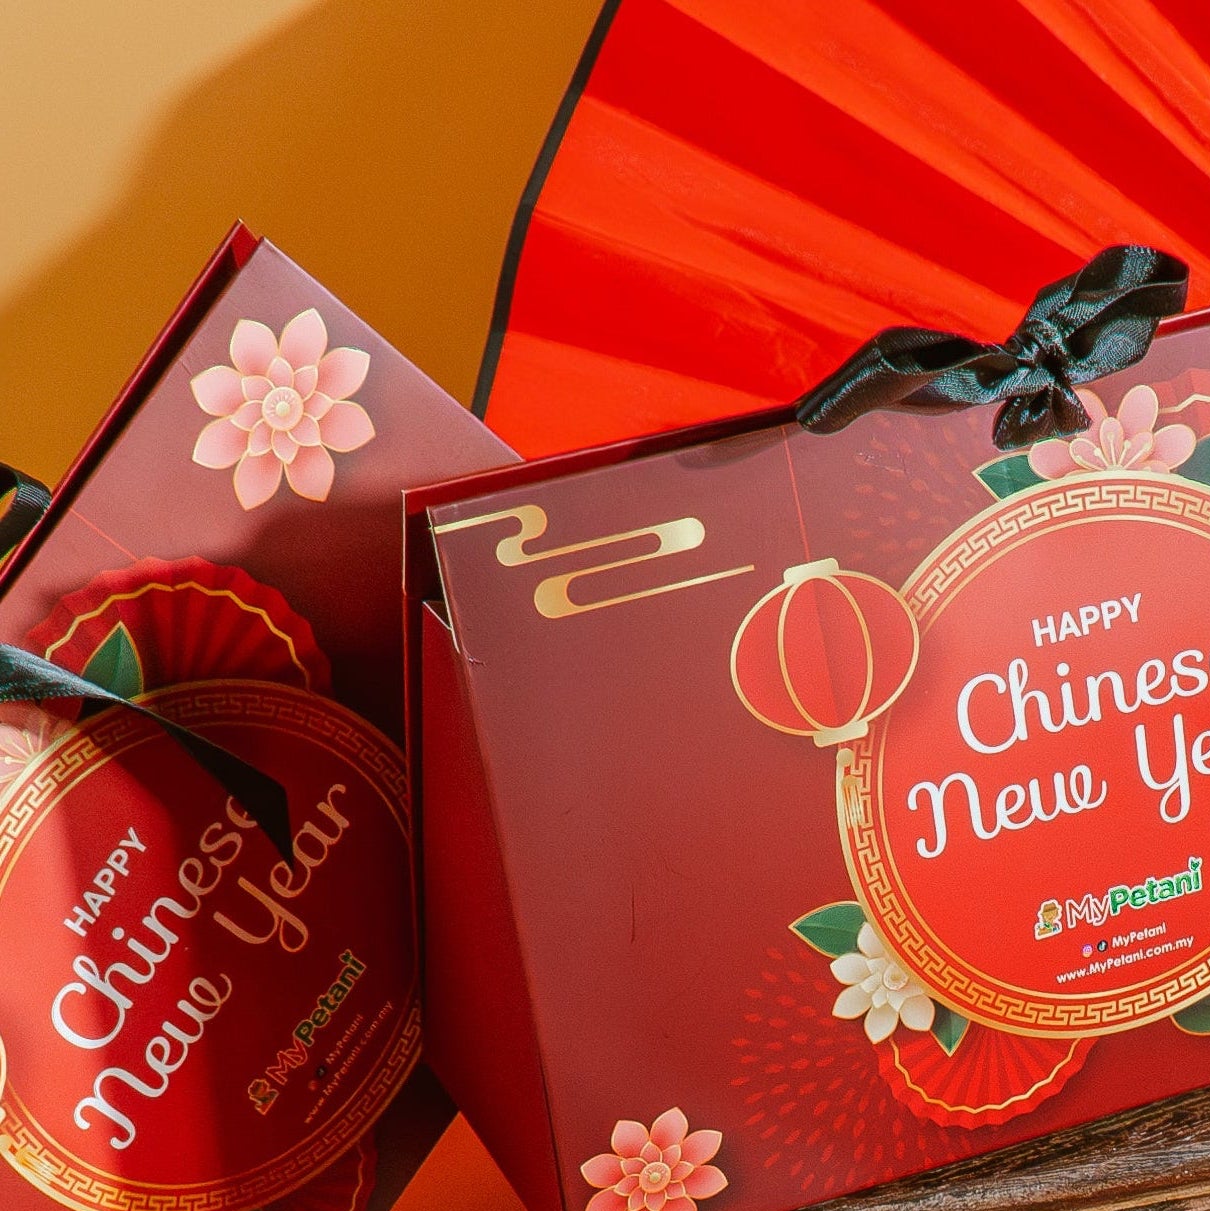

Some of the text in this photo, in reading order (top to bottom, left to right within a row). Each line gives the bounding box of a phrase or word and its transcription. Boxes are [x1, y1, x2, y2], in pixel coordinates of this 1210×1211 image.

[1031, 593, 1142, 647] HAPPY
[907, 764, 1108, 859] New
[63, 826, 148, 937] HAPPY
[1066, 856, 1203, 929] MyPetani
[73, 783, 350, 1150] New Year
[1056, 936, 1194, 984] www.MyPetani.com.my
[1111, 922, 1167, 948] MyPetani
[264, 949, 367, 1086] MyPetani
